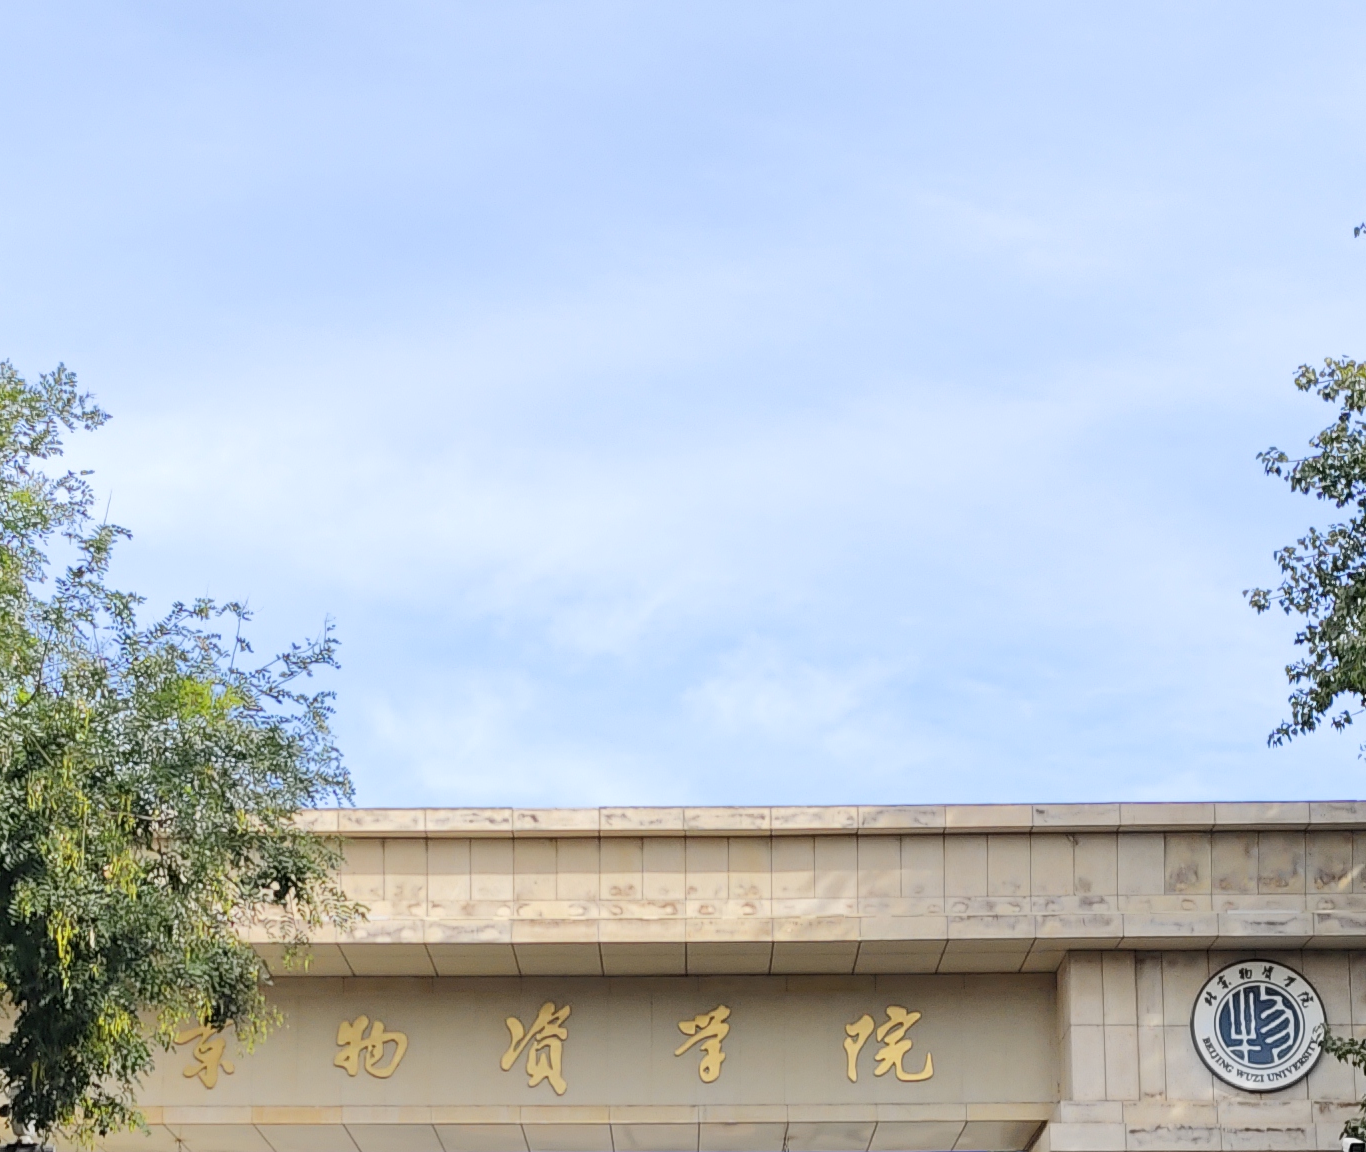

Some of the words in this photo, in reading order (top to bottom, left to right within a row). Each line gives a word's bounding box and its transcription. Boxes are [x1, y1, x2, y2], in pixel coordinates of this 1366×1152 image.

[1202, 1036, 1234, 1073] BEIJING
[1236, 1069, 1264, 1083] WUZI
[1267, 1038, 1319, 1082] UNIVERSITY
